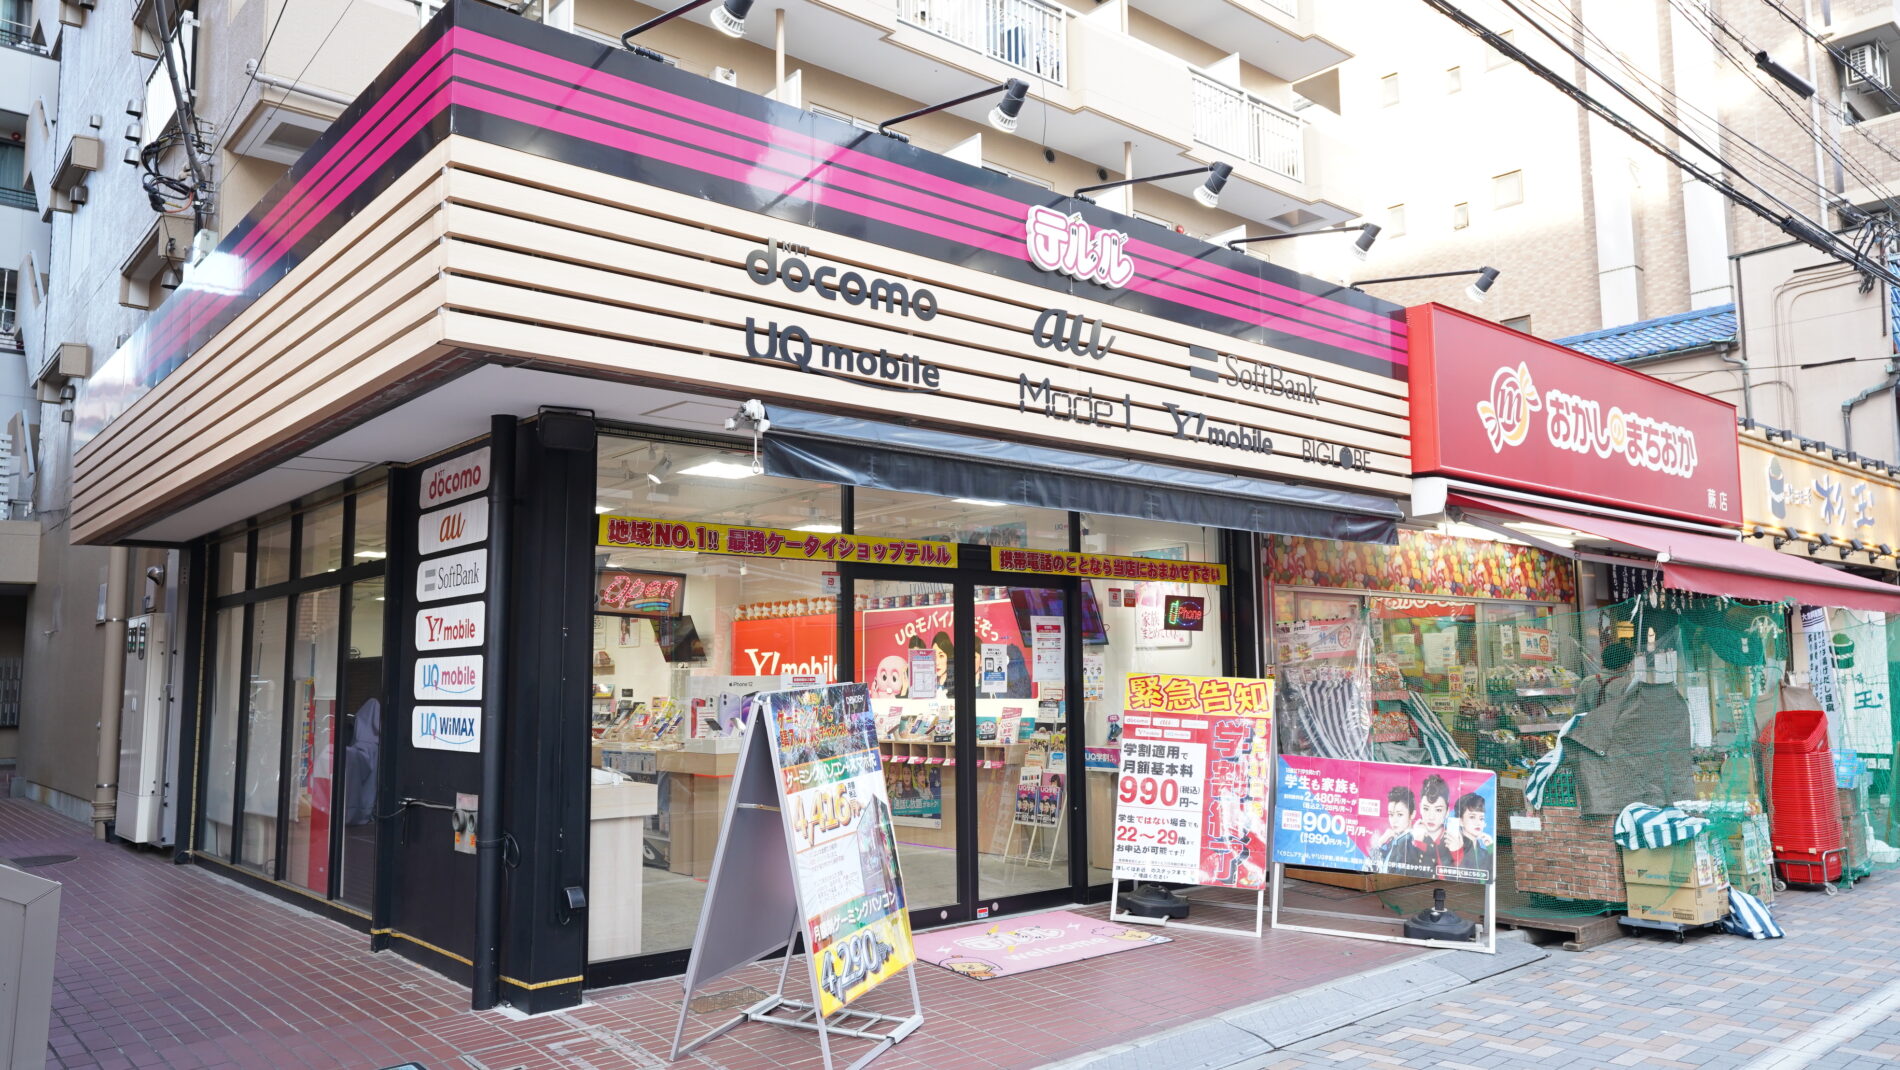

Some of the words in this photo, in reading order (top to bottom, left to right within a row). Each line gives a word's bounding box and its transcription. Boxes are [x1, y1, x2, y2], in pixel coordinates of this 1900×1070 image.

[781, 241, 810, 257] NTT
[1027, 206, 1135, 288] テルル
[745, 237, 938, 322] docomo
[1033, 309, 1116, 360] au
[745, 317, 812, 373] UQ
[822, 343, 940, 388] mobile
[1225, 354, 1320, 406] SoftBank
[1545, 389, 1699, 479] おかしのまちおか
[1302, 438, 1371, 474] BIGLOBE
[429, 464, 481, 500] docomo
[439, 511, 466, 543] au
[727, 528, 952, 566] 最強ケータイショップテルル
[437, 562, 480, 590] SoftBank
[999, 550, 1221, 584] 携帯電話のことなら当店におまかせ下さい
[604, 575, 679, 609] Open
[423, 664, 439, 690] UQ
[441, 665, 475, 687] mobile
[1129, 675, 1270, 714] 緊急告知
[421, 713, 437, 739] UQ
[439, 717, 475, 738] WiMAX
[1123, 743, 1188, 760] 学割適用で
[1123, 760, 1193, 778] 月額基本料
[1284, 774, 1359, 795] 学生も家族も
[1119, 776, 1179, 807] 990
[1303, 812, 1346, 835] 900
[1006, 937, 1109, 961] welcome
[821, 928, 881, 1005] 4,290
